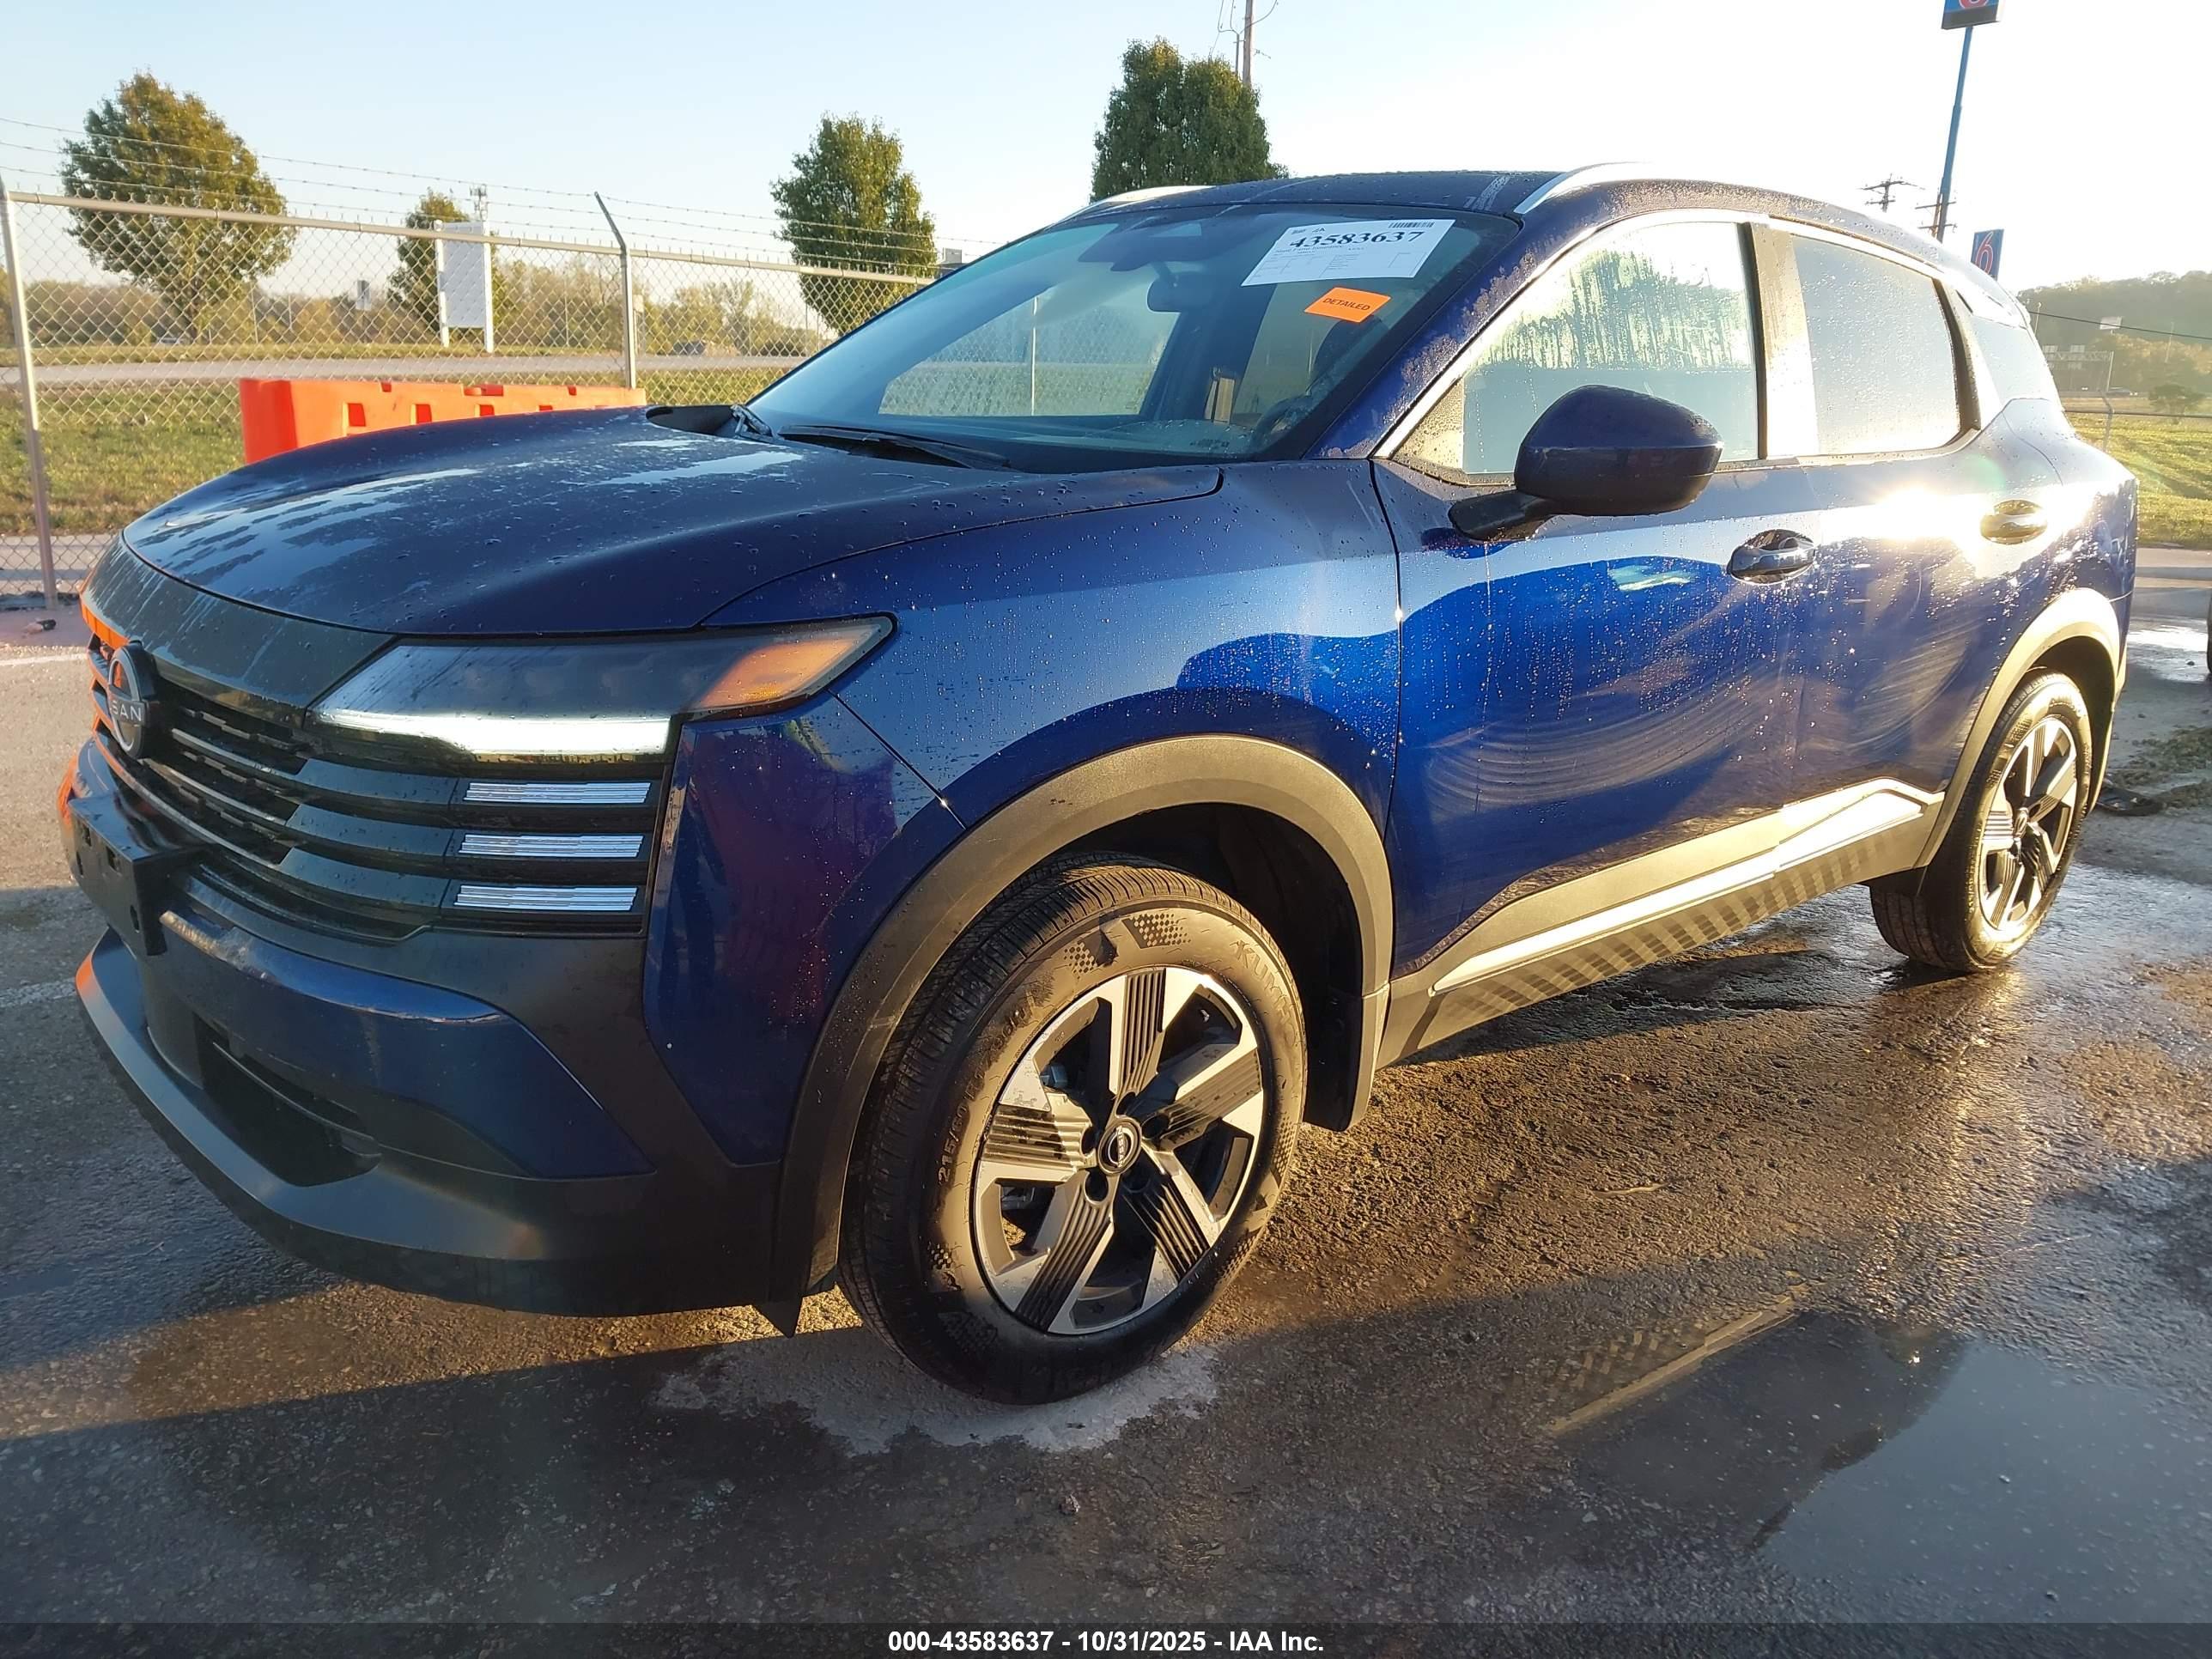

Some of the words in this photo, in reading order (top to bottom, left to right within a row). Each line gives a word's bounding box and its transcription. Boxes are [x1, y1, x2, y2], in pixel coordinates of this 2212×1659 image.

[1290, 231, 1425, 247] 43583637
[1975, 231, 1994, 275] 6
[1322, 297, 1370, 311] DETAILED
[1229, 939, 1297, 1048] KUMHO
[1116, 1125, 1125, 1168] NISSAN
